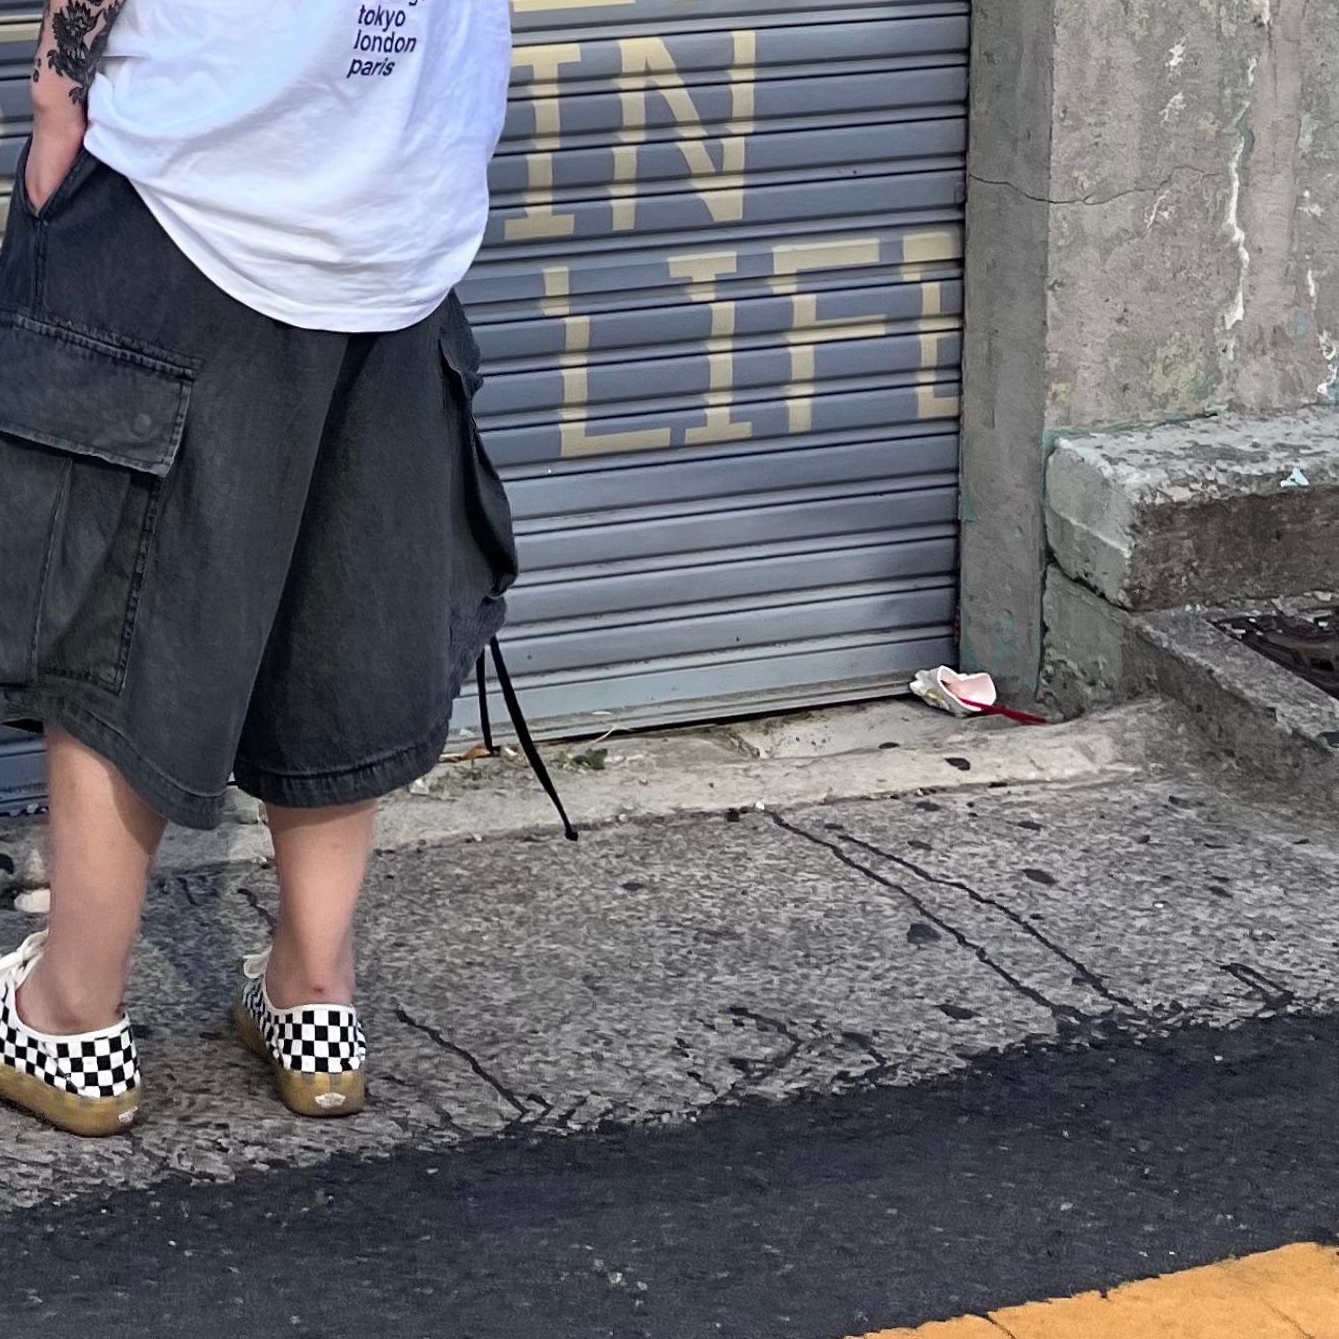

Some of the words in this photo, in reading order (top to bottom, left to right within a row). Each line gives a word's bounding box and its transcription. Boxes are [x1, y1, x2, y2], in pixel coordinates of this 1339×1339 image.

[358, 4, 405, 32] tokyo
[353, 29, 417, 53] london
[346, 58, 395, 78] paris
